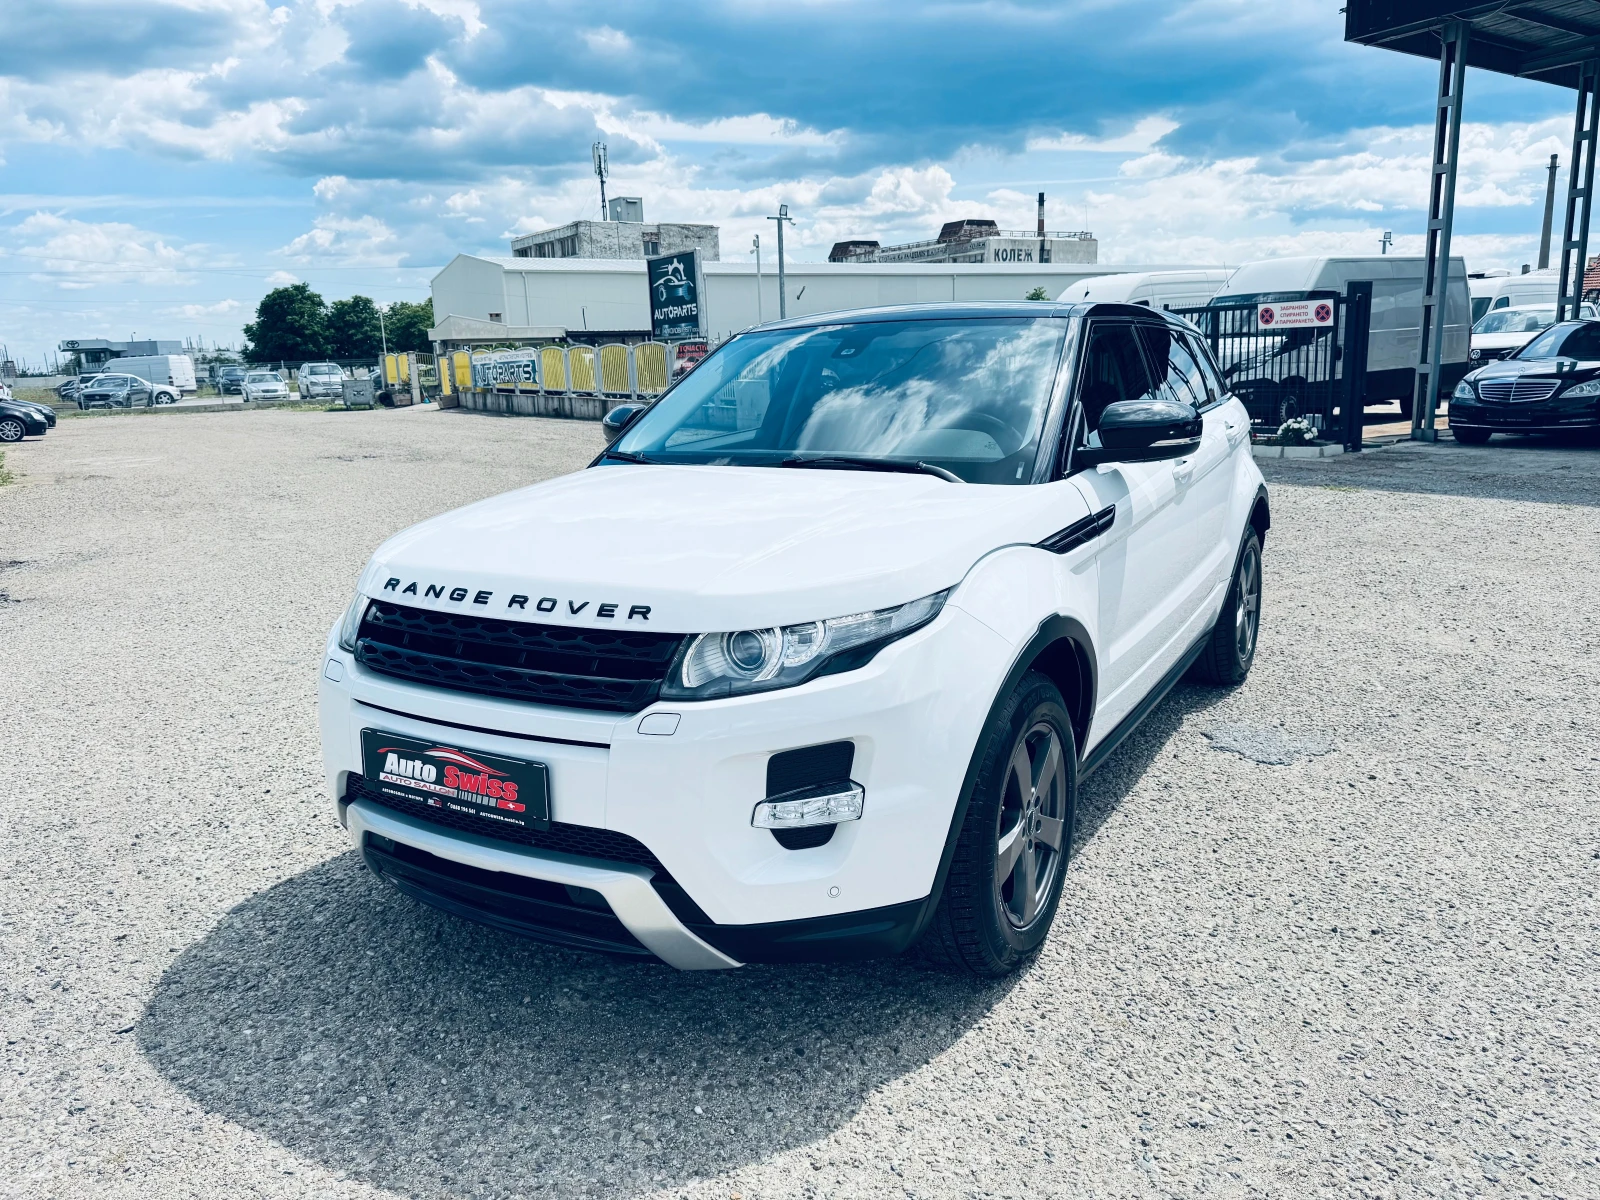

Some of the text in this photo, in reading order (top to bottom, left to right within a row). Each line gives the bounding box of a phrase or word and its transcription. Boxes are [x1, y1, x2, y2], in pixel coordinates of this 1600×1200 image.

[994, 248, 1033, 262] КОЛЕЖ
[654, 303, 698, 320] AUTOPARTS
[476, 361, 533, 384] AUTOPARTS
[383, 577, 652, 621] RANGE ROVER
[383, 775, 455, 796] AUTO SALLON
[384, 752, 519, 801] Auto Swiss
